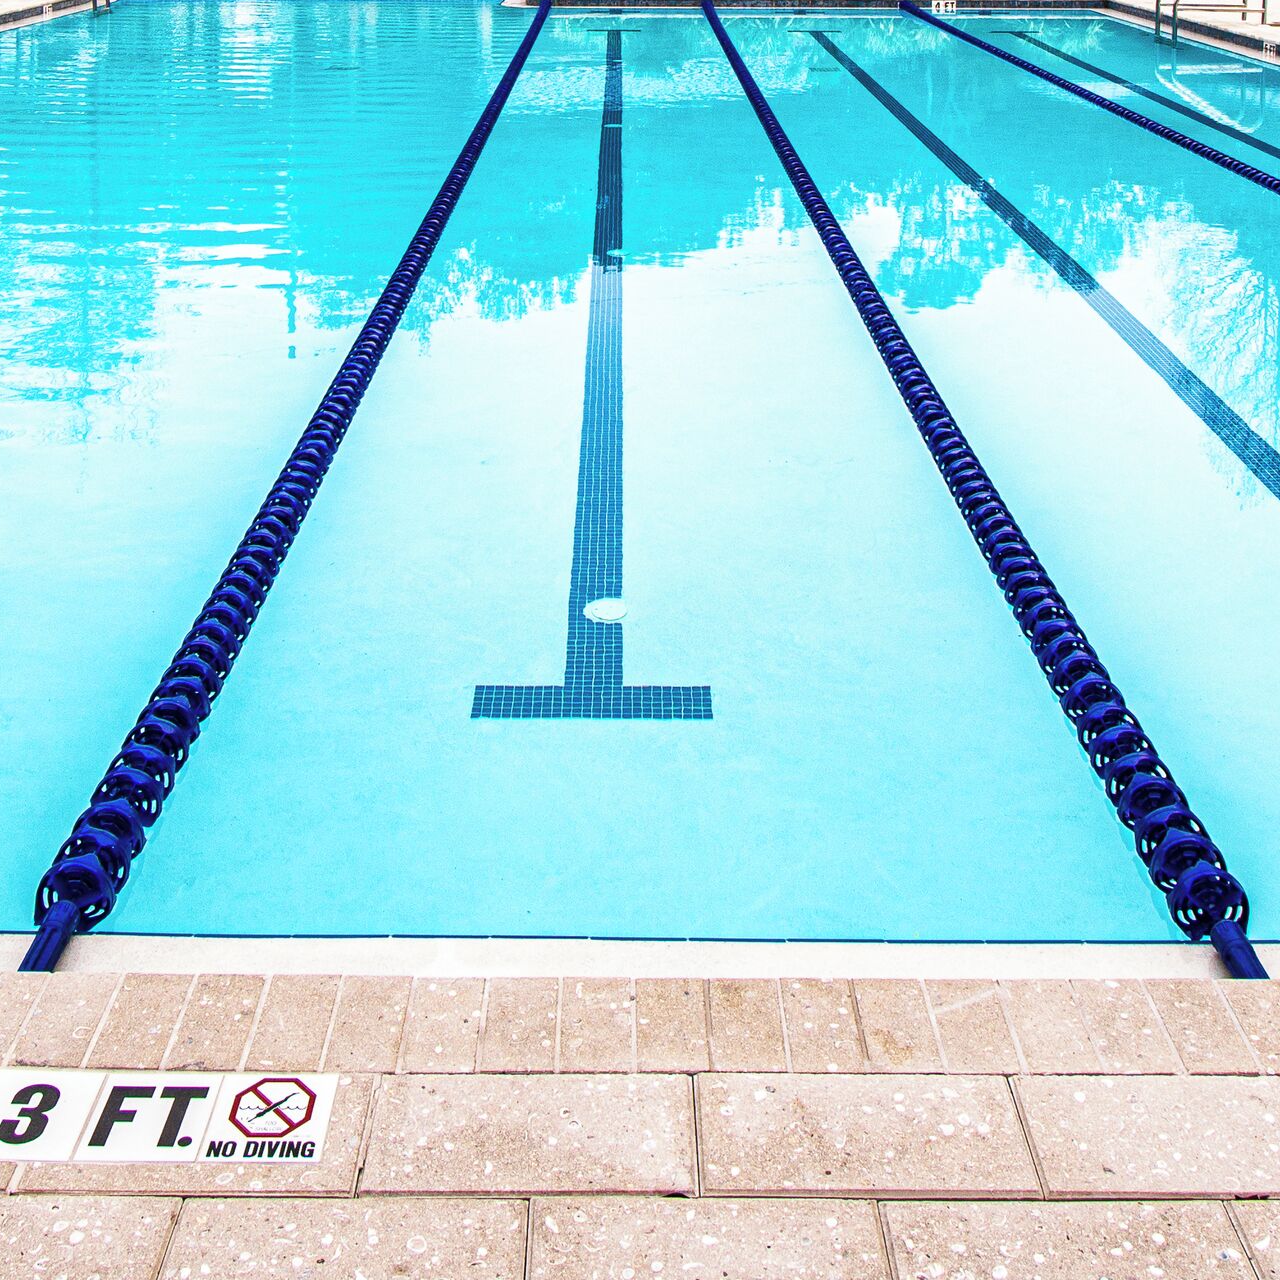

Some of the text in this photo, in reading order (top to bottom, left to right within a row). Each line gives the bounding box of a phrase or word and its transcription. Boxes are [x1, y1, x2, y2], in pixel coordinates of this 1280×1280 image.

[87, 1085, 210, 1148] FT.
[206, 1140, 316, 1158] NO DIVING
